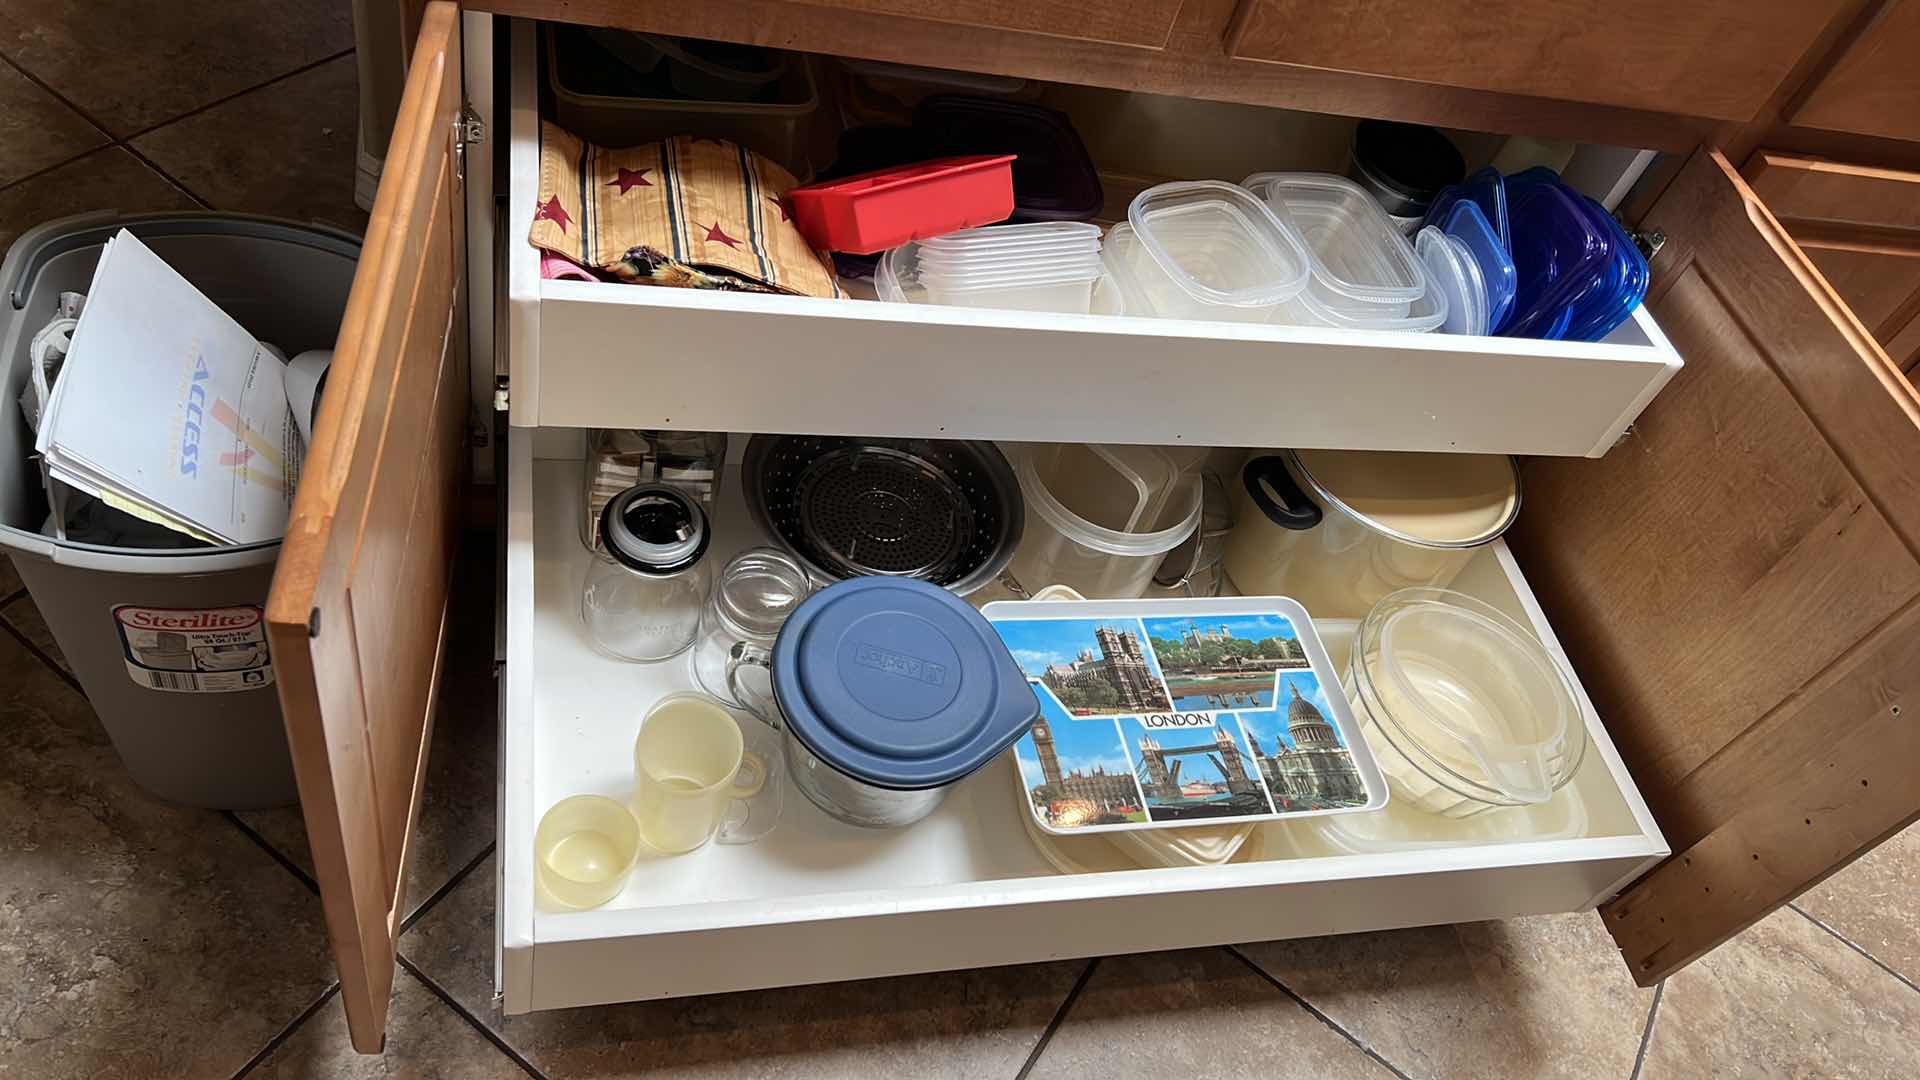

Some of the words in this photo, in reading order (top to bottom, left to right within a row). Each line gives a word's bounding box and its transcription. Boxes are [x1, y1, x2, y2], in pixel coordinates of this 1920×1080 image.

[181, 353, 208, 480] ACCESS
[133, 612, 245, 627] Sterilite
[1144, 713, 1211, 727] LONDON
